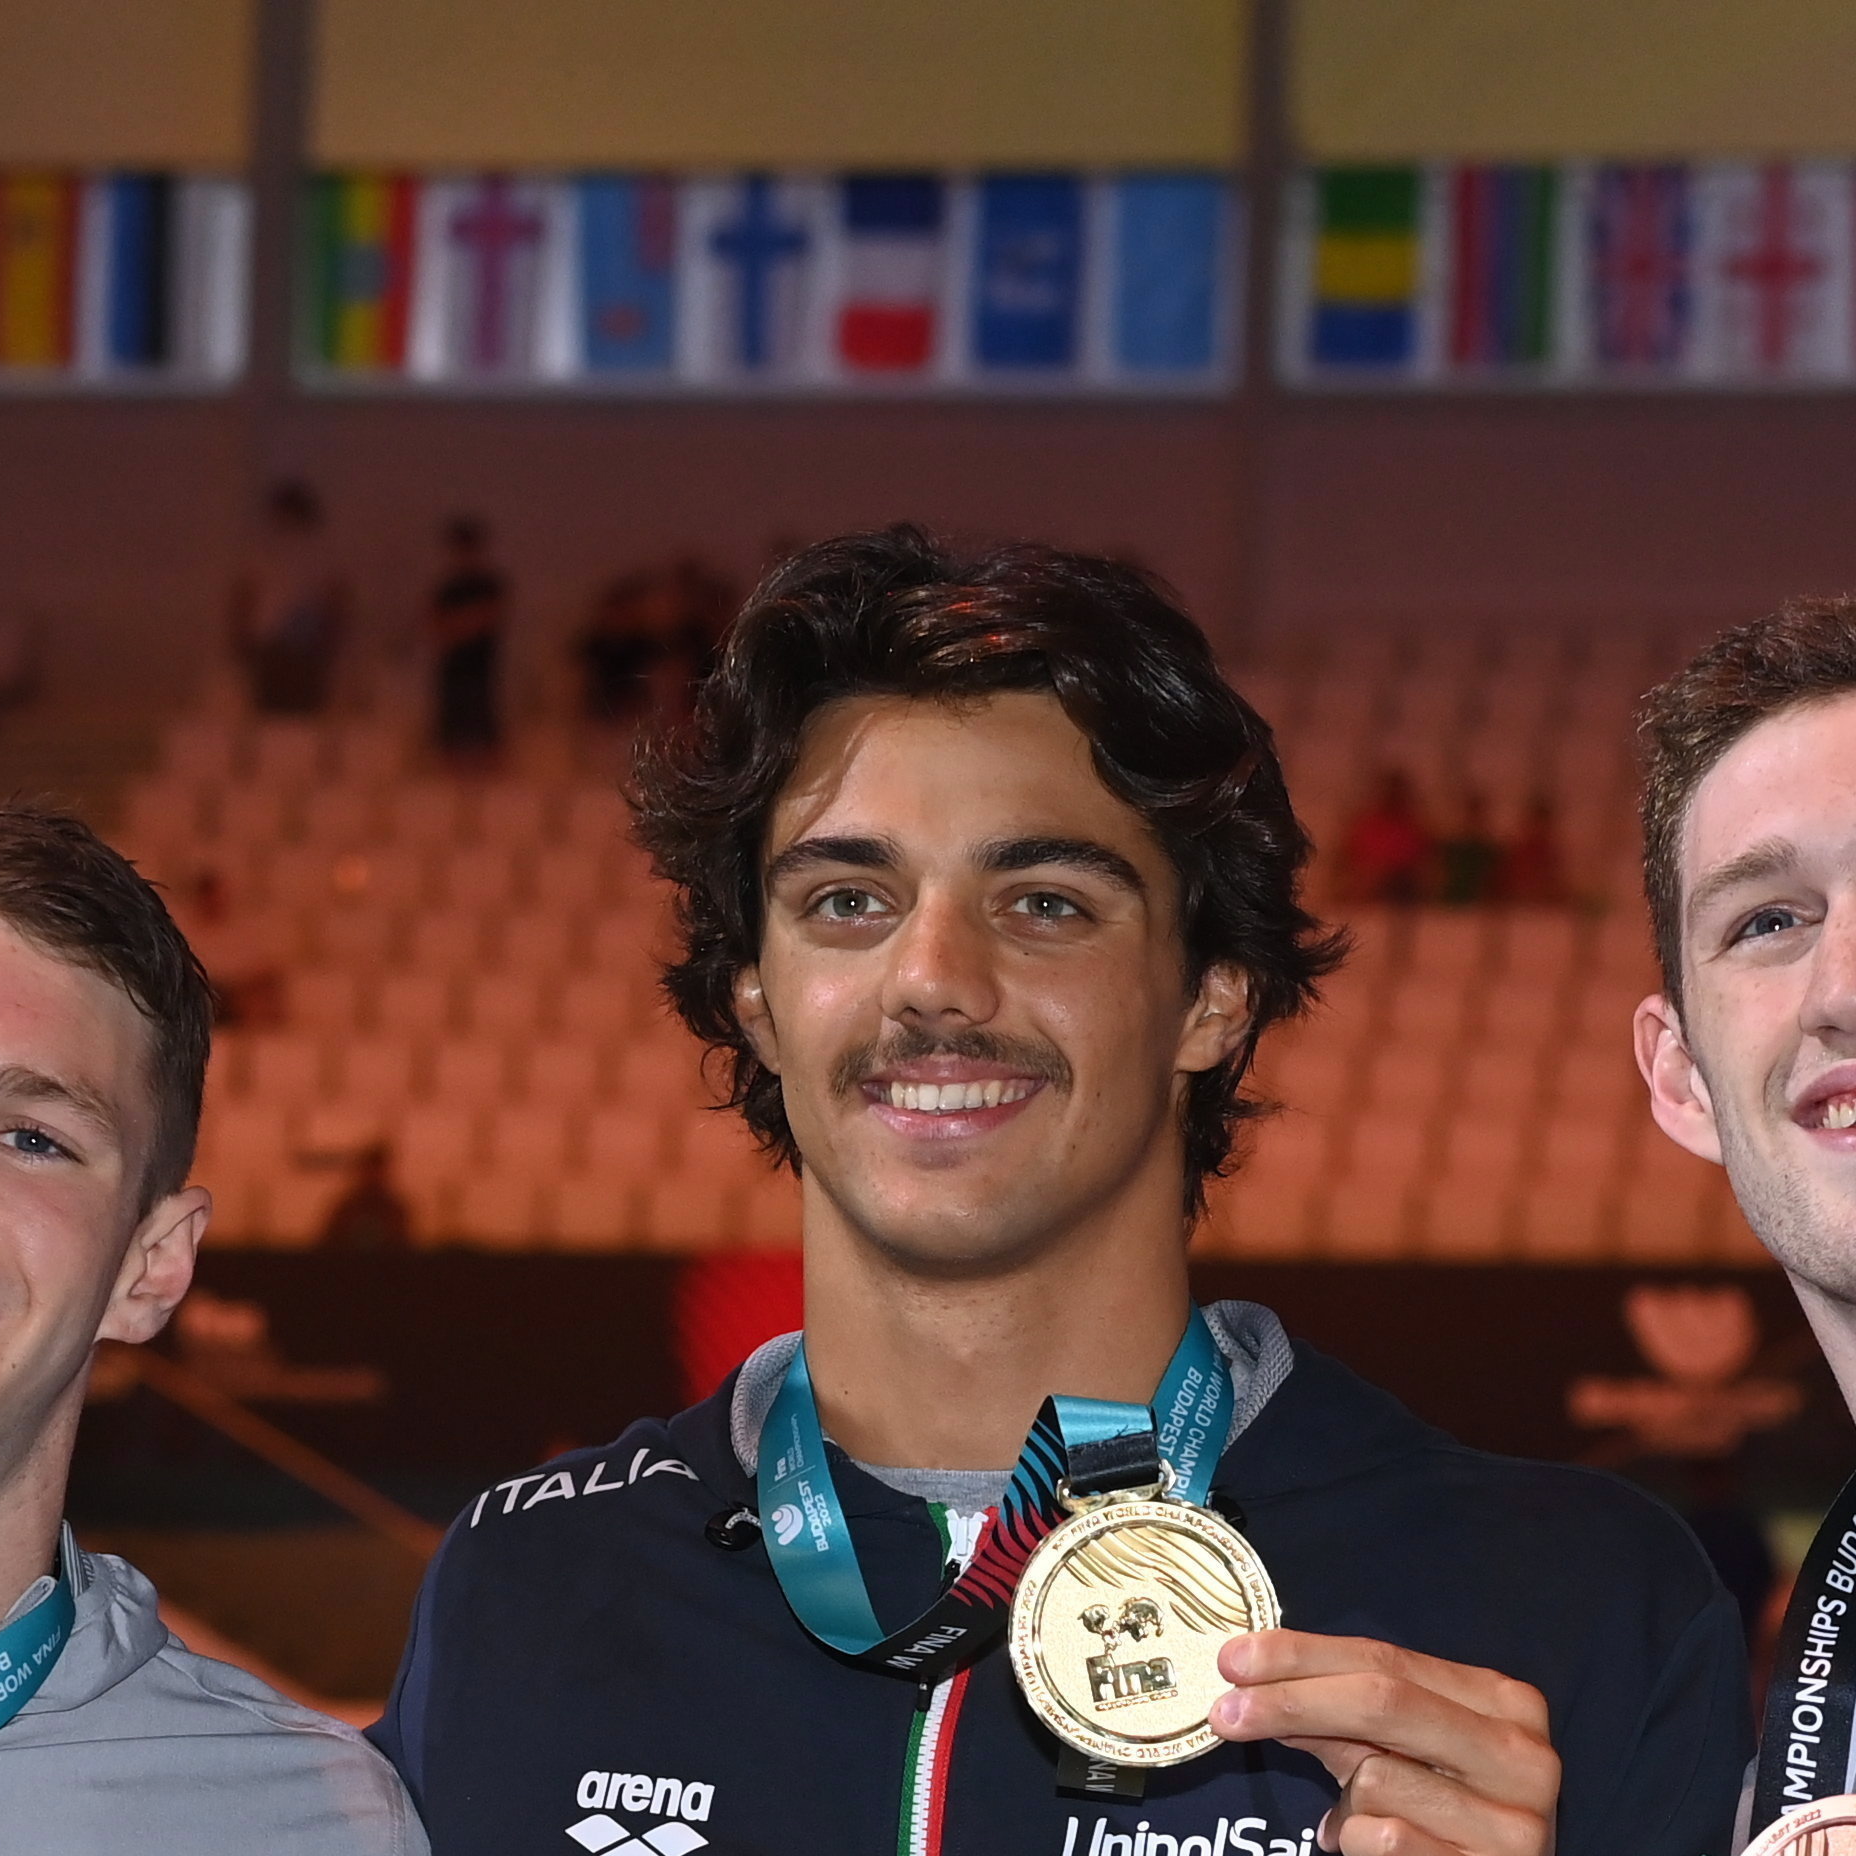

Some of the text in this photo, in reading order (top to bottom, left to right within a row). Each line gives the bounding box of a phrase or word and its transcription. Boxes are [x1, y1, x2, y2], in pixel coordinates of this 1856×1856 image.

[1158, 1366, 1203, 1456] BUDAPEST
[1193, 1371, 1224, 1427] WORLD
[470, 1448, 700, 1529] ITALIA
[814, 1494, 832, 1527] 2022
[797, 1480, 830, 1552] BUDAPEST
[32, 1625, 62, 1666] FINA
[904, 1625, 968, 1654] FINA
[577, 1770, 715, 1822] arena
